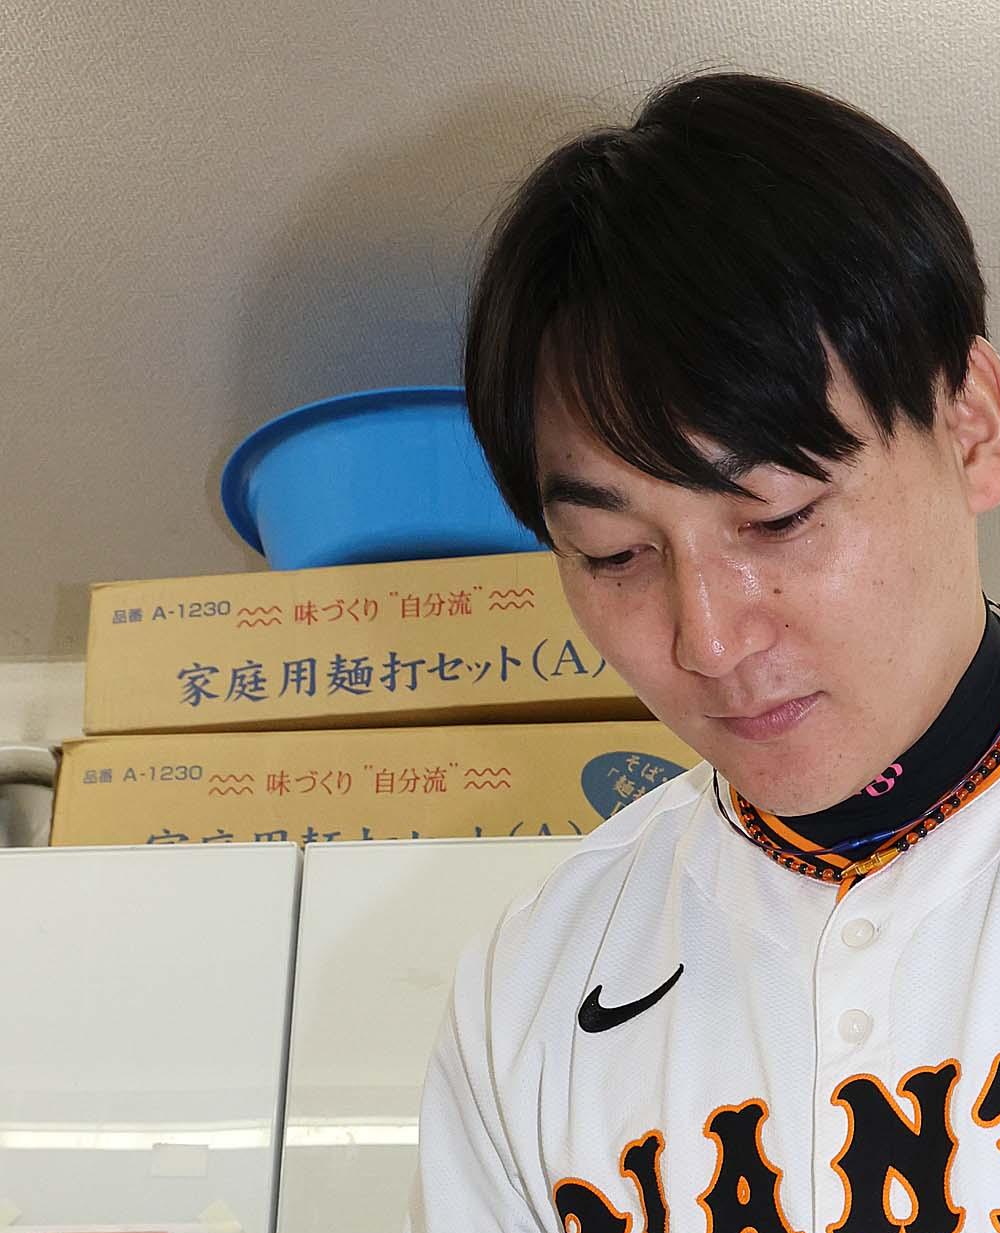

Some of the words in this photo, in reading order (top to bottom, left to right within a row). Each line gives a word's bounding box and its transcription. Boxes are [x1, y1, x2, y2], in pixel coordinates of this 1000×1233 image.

[112, 609, 144, 625] 品番
[152, 600, 231, 621] A-1230
[294, 597, 379, 626] 味づくり
[83, 769, 113, 784] 品番
[123, 765, 203, 783] A-1230
[266, 769, 352, 797] 味づくり
